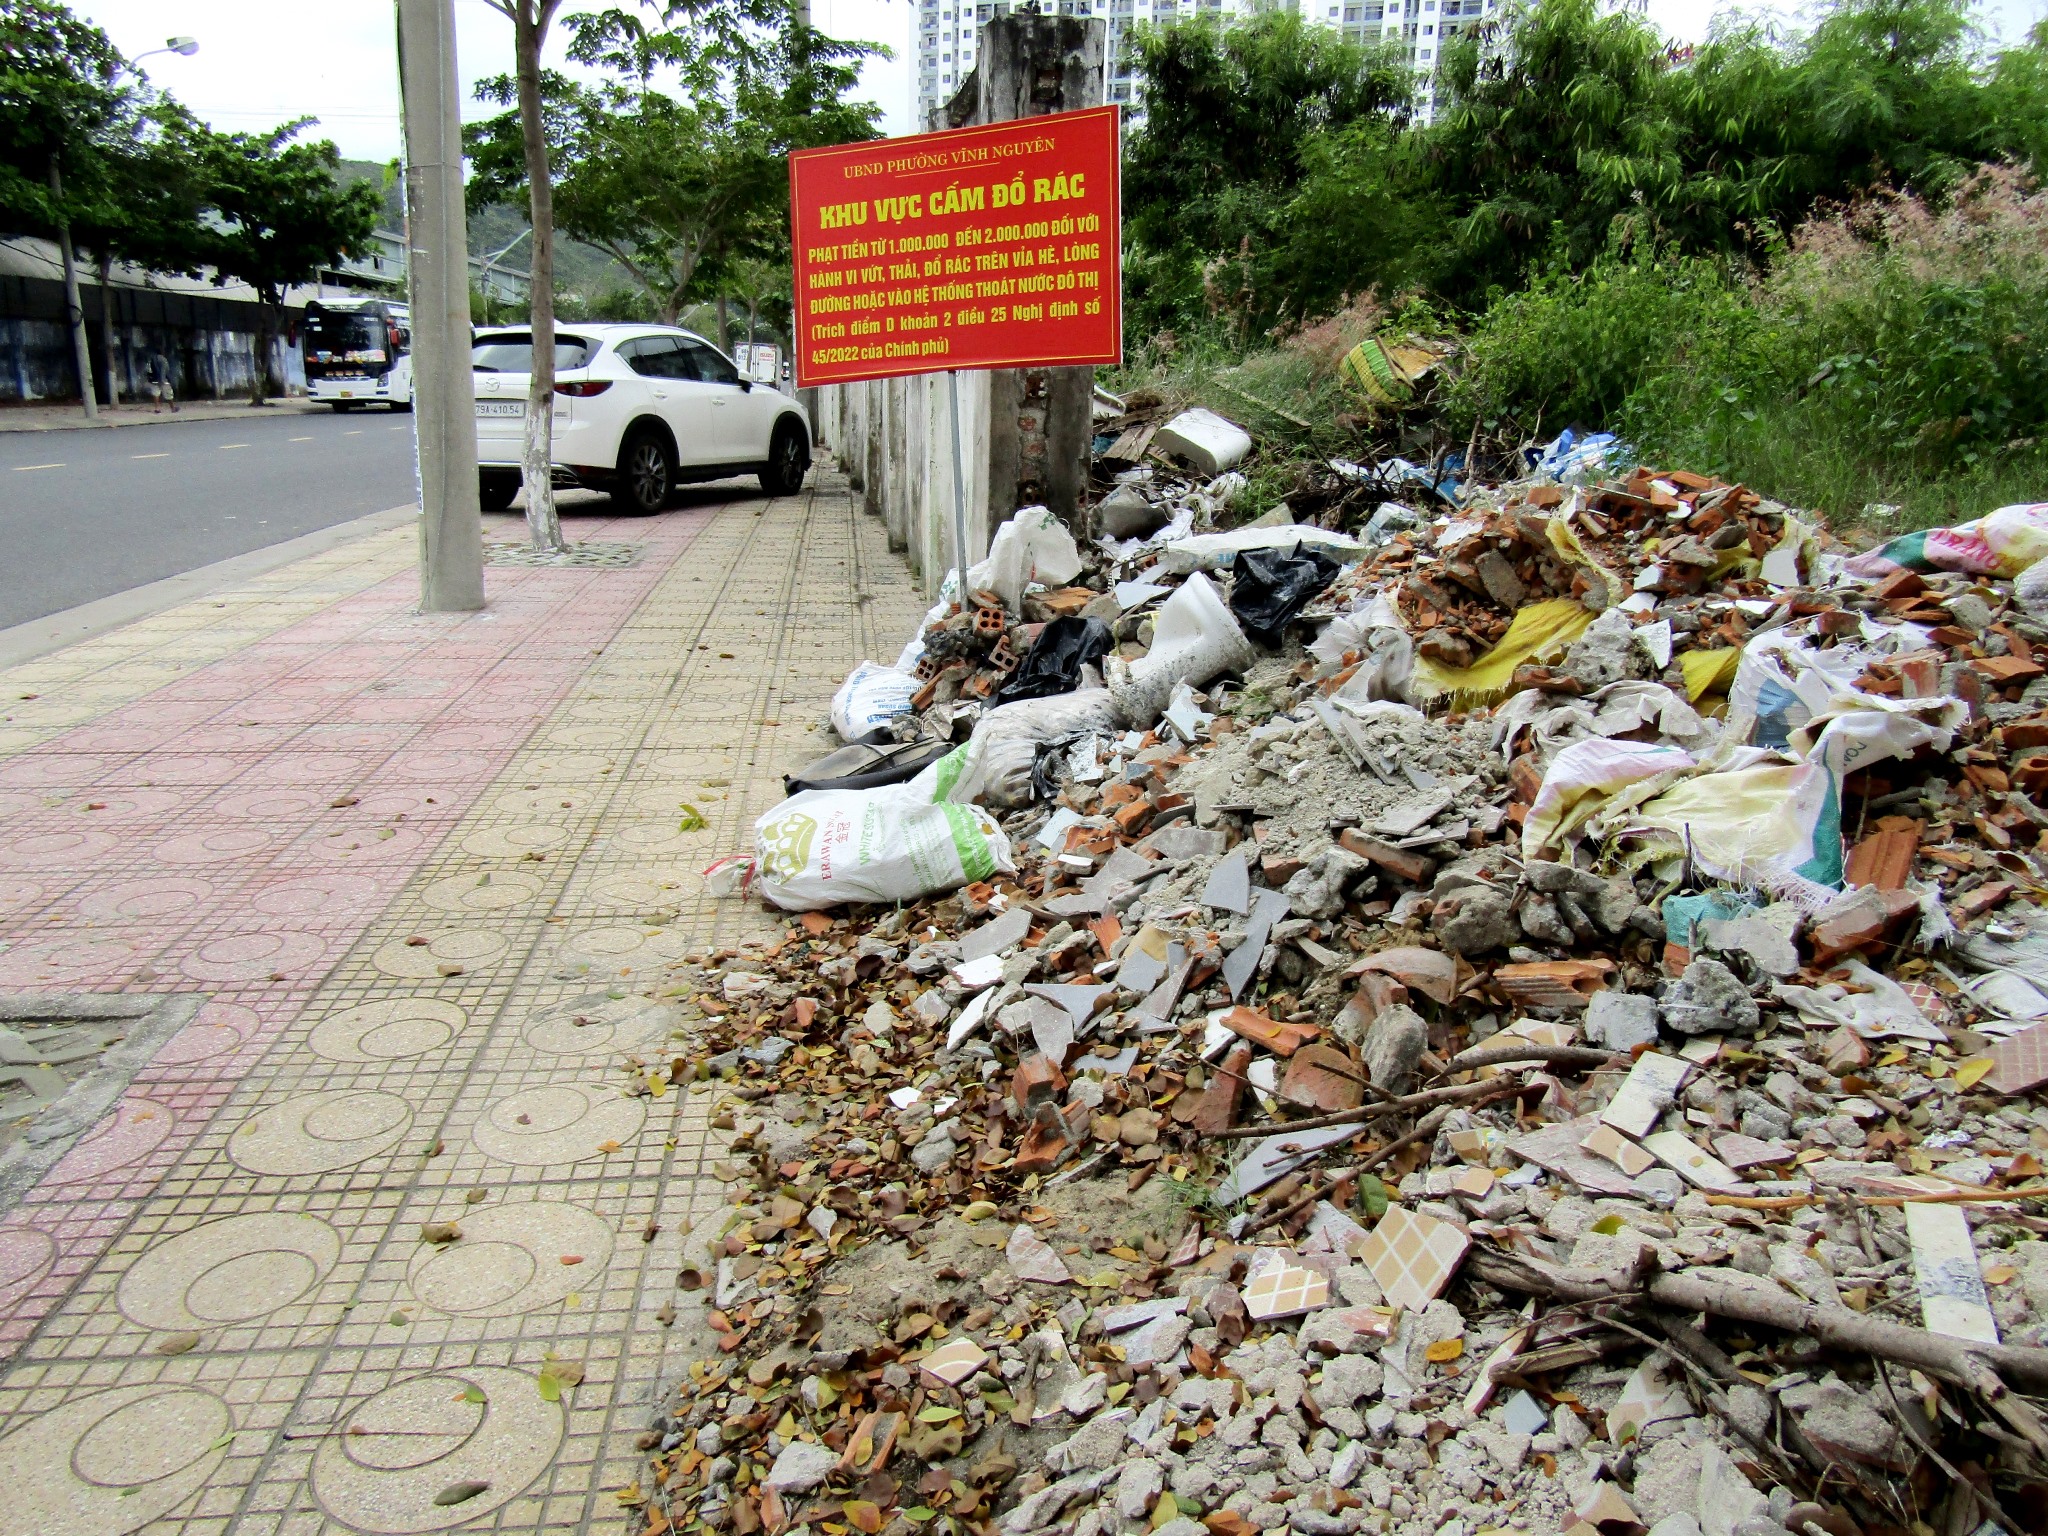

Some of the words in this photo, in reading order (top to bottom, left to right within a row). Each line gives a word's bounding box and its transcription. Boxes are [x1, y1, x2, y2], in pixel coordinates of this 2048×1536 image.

[844, 162, 883, 178] UBND
[887, 152, 947, 172] PHƯỜNG
[951, 147, 988, 163] VĨNH
[993, 136, 1055, 158] NGUYÊN
[820, 201, 867, 229] KHU
[874, 195, 922, 224] VỰC
[929, 181, 984, 215] CẤM
[992, 171, 1025, 208] ĐỔ
[1034, 171, 1085, 203] RÁC
[808, 246, 838, 265] PHẠT
[841, 239, 869, 259] TIỀN
[871, 238, 887, 256] TỪ
[889, 233, 949, 254] 1.000.000
[956, 225, 982, 246] ĐẾN
[984, 222, 1048, 243] 2.000.000
[1051, 213, 1074, 236] ĐỐI
[1077, 213, 1099, 233] VỚI
[809, 270, 842, 289] HÀNH
[846, 270, 857, 285] VI
[861, 265, 885, 283] VỨT,
[889, 259, 920, 280] THẢI,
[924, 254, 941, 277] ĐỔ
[945, 255, 971, 275] RÁC
[975, 251, 1009, 271] TRÊN
[1012, 246, 1034, 267] VỈA
[1038, 245, 1060, 265] HÈ,
[1064, 241, 1099, 262] LÒNG
[810, 295, 851, 314] ĐƯỜNG
[853, 290, 885, 311] HOẶC
[887, 288, 911, 306] VÀO
[914, 285, 930, 306] HỆ
[931, 280, 973, 302] THỐNG
[976, 277, 1016, 297] THOÁT
[1018, 273, 1054, 293] NƯỚC
[1057, 270, 1075, 290] ĐÔ
[1077, 271, 1099, 291] THỊ
[812, 323, 845, 341] (Trích
[851, 316, 880, 336] điểm
[900, 312, 938, 331] khoản
[943, 312, 951, 327] 2
[957, 307, 985, 325] điều
[991, 307, 1007, 322] 25
[1013, 303, 1043, 322] Nghị
[1049, 301, 1078, 320] định
[1084, 296, 1101, 315] số
[812, 346, 859, 364] 45/2022
[861, 343, 883, 359] của
[885, 340, 919, 357] Chính
[922, 336, 949, 356] phủ)
[820, 829, 833, 881] ERAWAN
